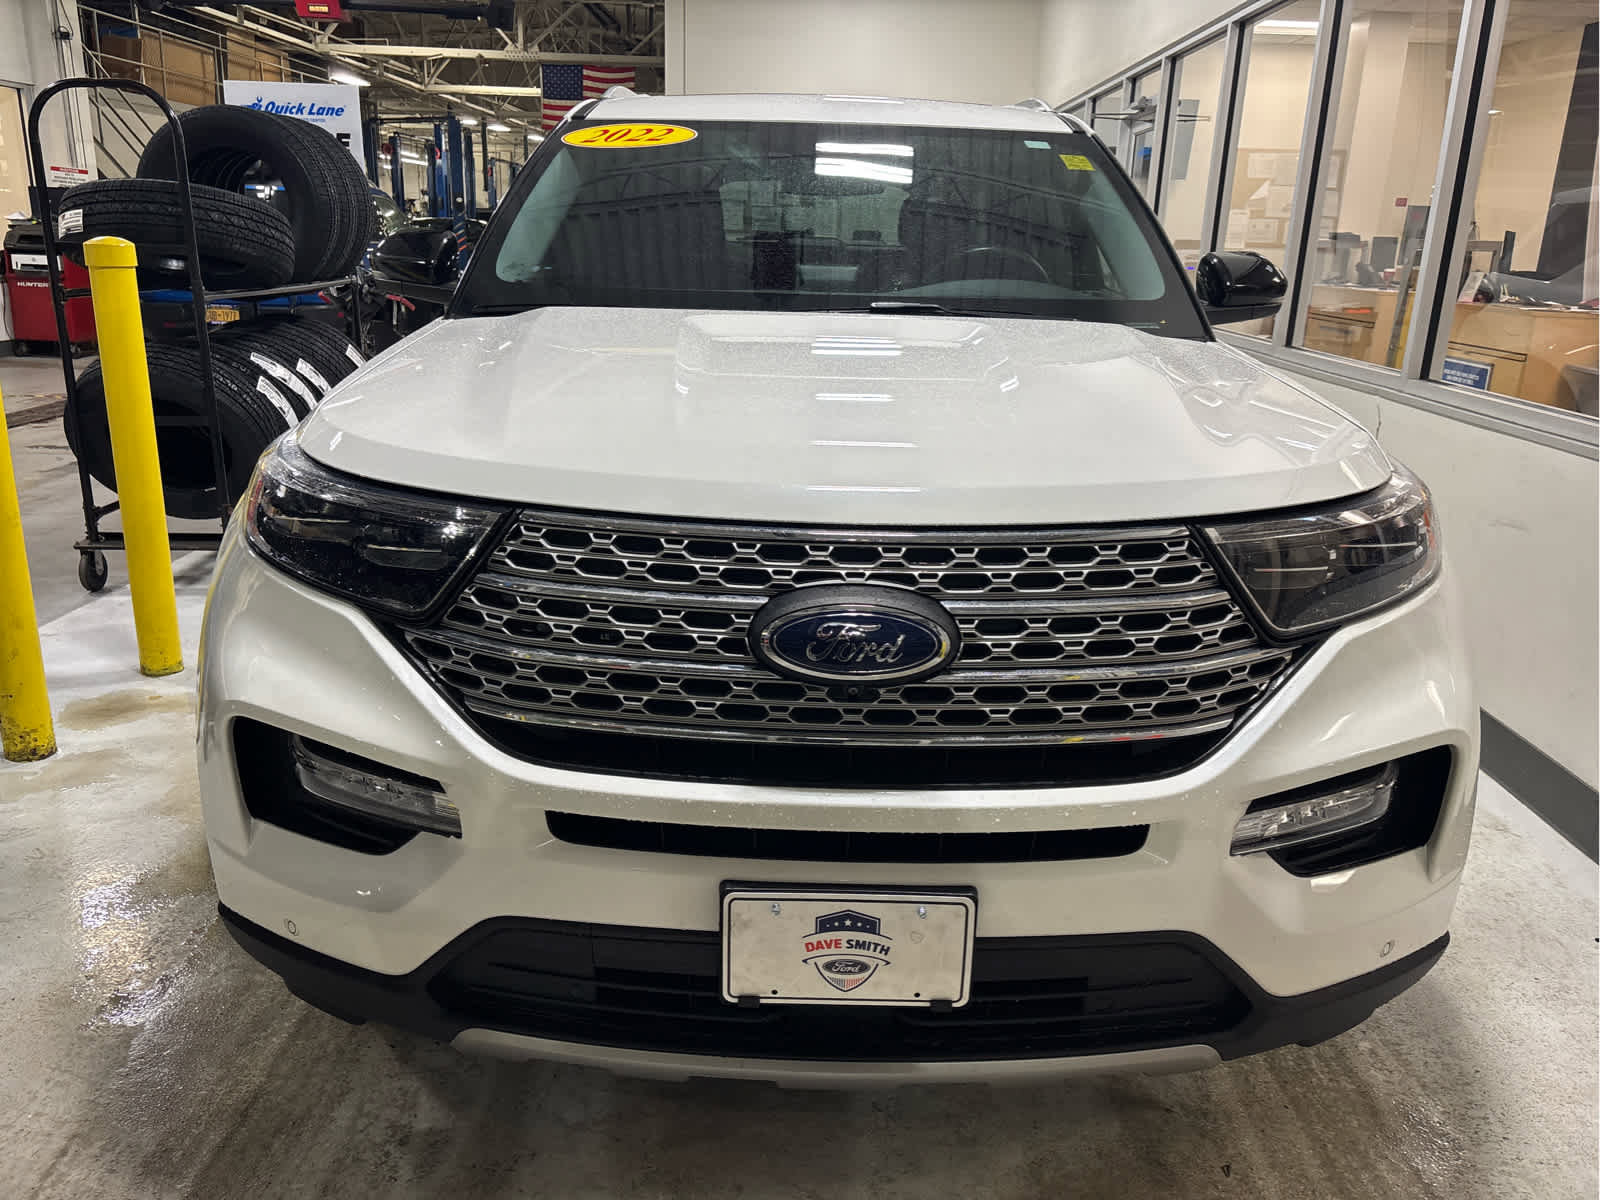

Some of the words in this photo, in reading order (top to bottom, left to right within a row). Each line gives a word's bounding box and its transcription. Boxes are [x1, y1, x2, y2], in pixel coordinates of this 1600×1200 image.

[264, 101, 305, 116] Quick
[308, 103, 345, 117] Lane
[580, 128, 675, 144] 2022
[806, 621, 906, 663] Ford
[804, 938, 843, 953] DAVE
[846, 938, 891, 956] SMITH
[831, 960, 862, 973] Ford
